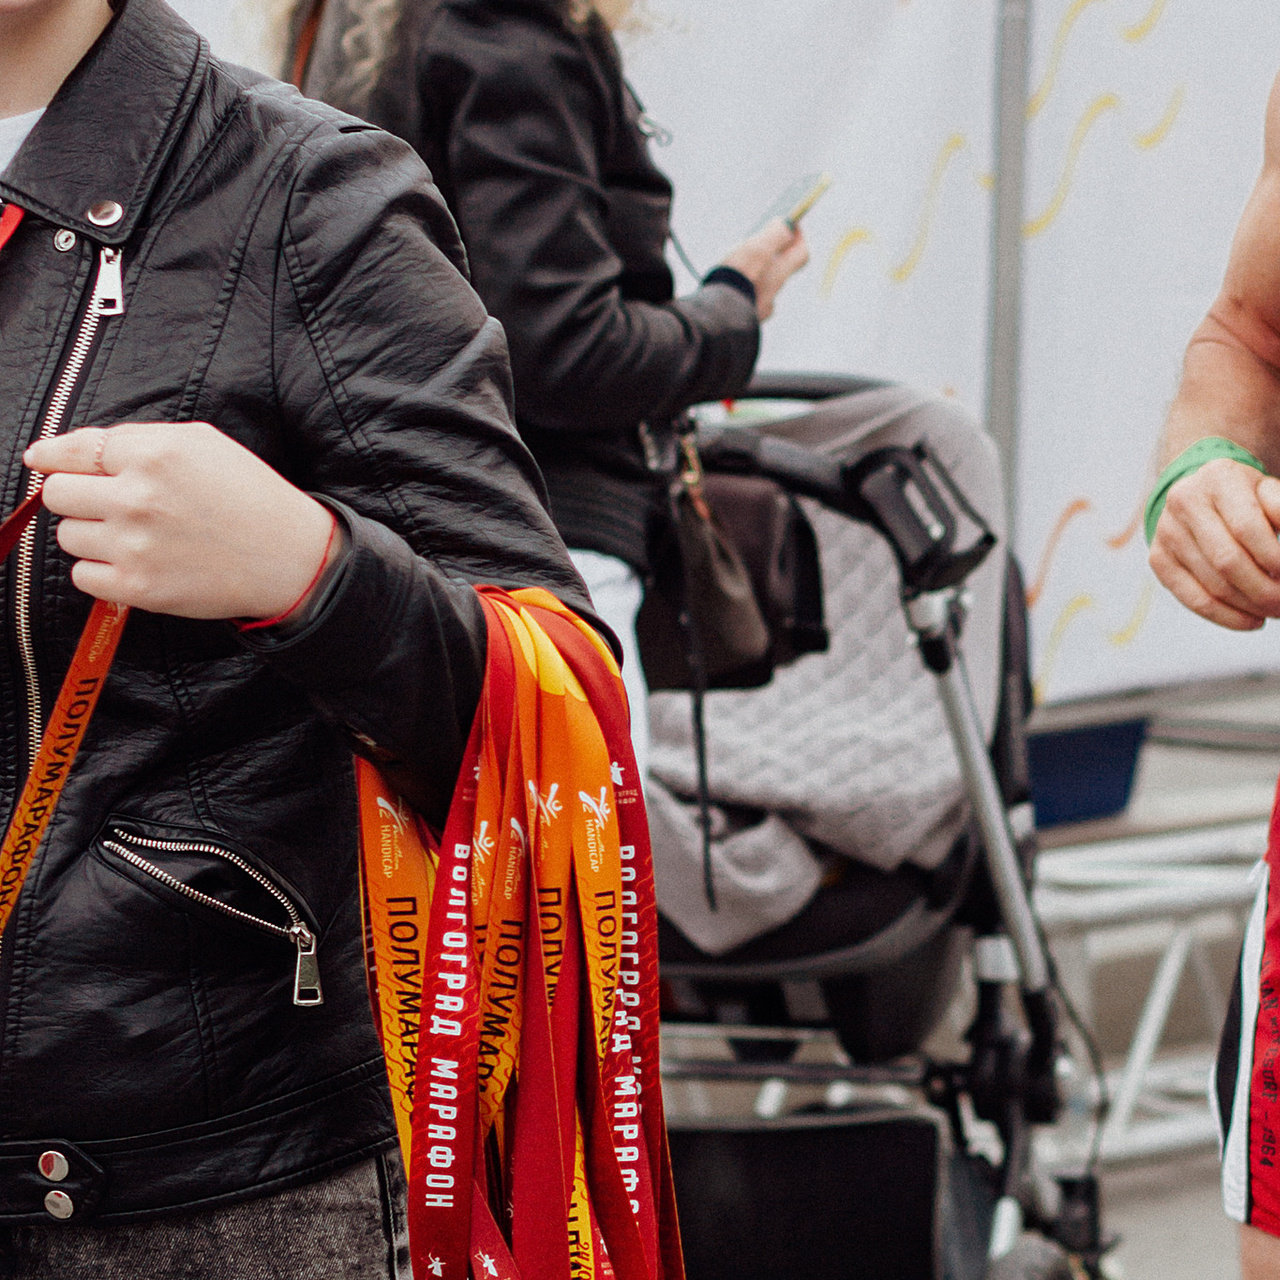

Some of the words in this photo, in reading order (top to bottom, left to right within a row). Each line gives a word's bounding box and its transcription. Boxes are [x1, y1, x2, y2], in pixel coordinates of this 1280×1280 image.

[380, 824, 393, 878] HANDICAP
[504, 846, 517, 900] HANDICAP
[585, 819, 600, 873] HANDICAP
[386, 896, 422, 1124] ПОЛУМАРА
[429, 843, 470, 1036] ВОЛГОГРАД
[478, 920, 523, 1093] ПОЛУМАР
[595, 890, 617, 1062] ПОЛУМА
[425, 1057, 460, 1210] МАРАФОН
[613, 1074, 640, 1215] МАРАФ
